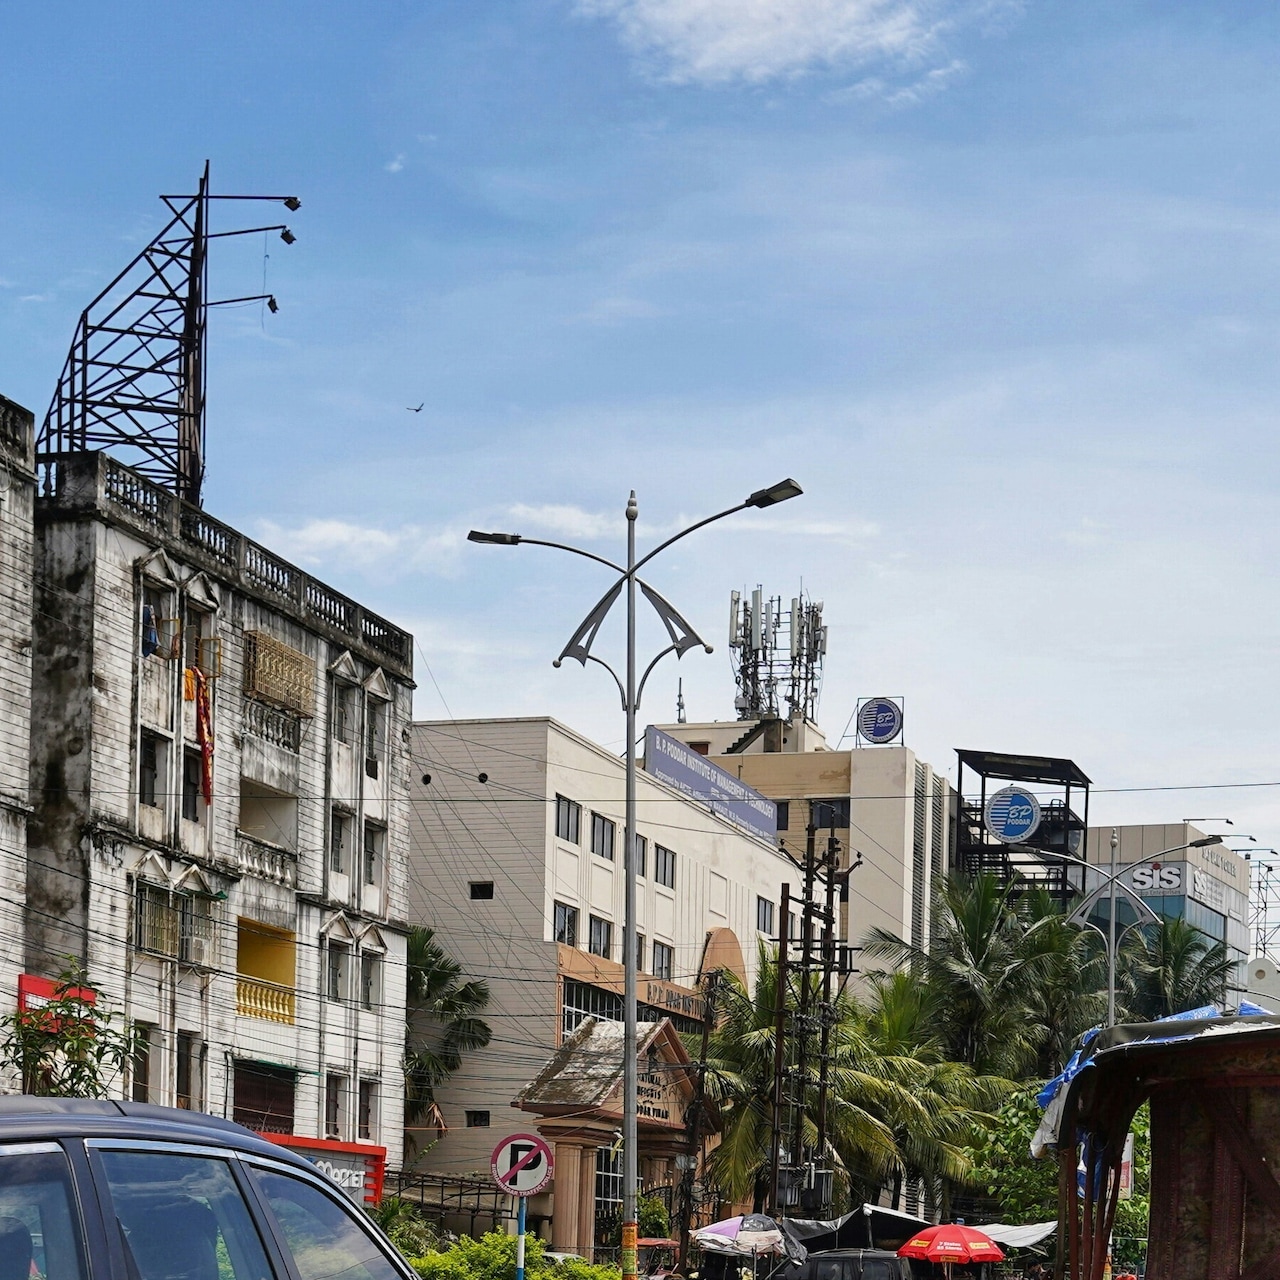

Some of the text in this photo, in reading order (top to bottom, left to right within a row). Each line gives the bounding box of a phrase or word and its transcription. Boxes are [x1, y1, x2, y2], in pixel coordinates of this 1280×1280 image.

[666, 741, 687, 767] PODDAR
[687, 752, 711, 781] INSTITUTE
[710, 767, 717, 783] OF
[716, 770, 745, 801] MANAGEMENT
[748, 791, 774, 820] TECHNOLOGY
[520, 1185, 543, 1197] TRAFFIC
[542, 1165, 553, 1187] POLICE
